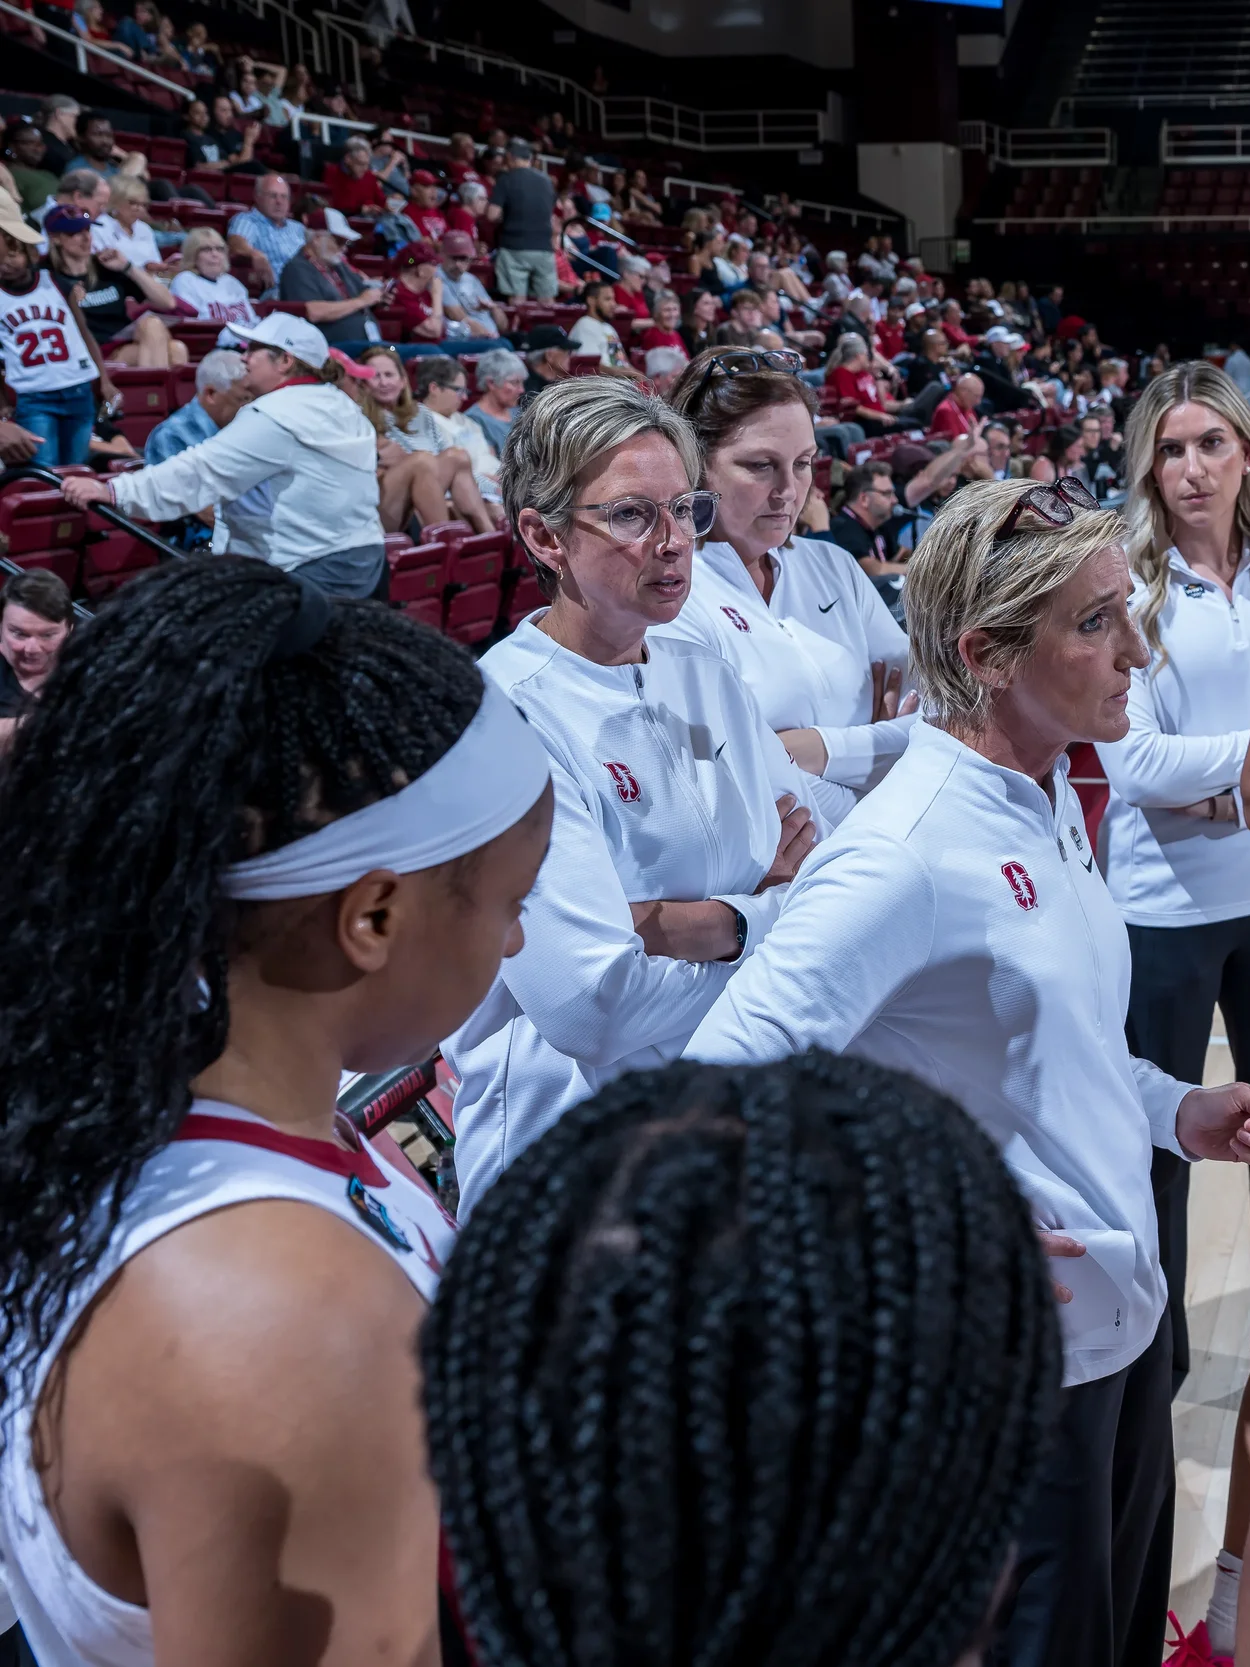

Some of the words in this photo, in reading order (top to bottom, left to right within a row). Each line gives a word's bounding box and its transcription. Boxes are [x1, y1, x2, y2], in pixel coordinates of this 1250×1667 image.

[1, 304, 66, 335] JORDAN
[16, 328, 70, 368] 23
[363, 1067, 426, 1129] CARDINAL
